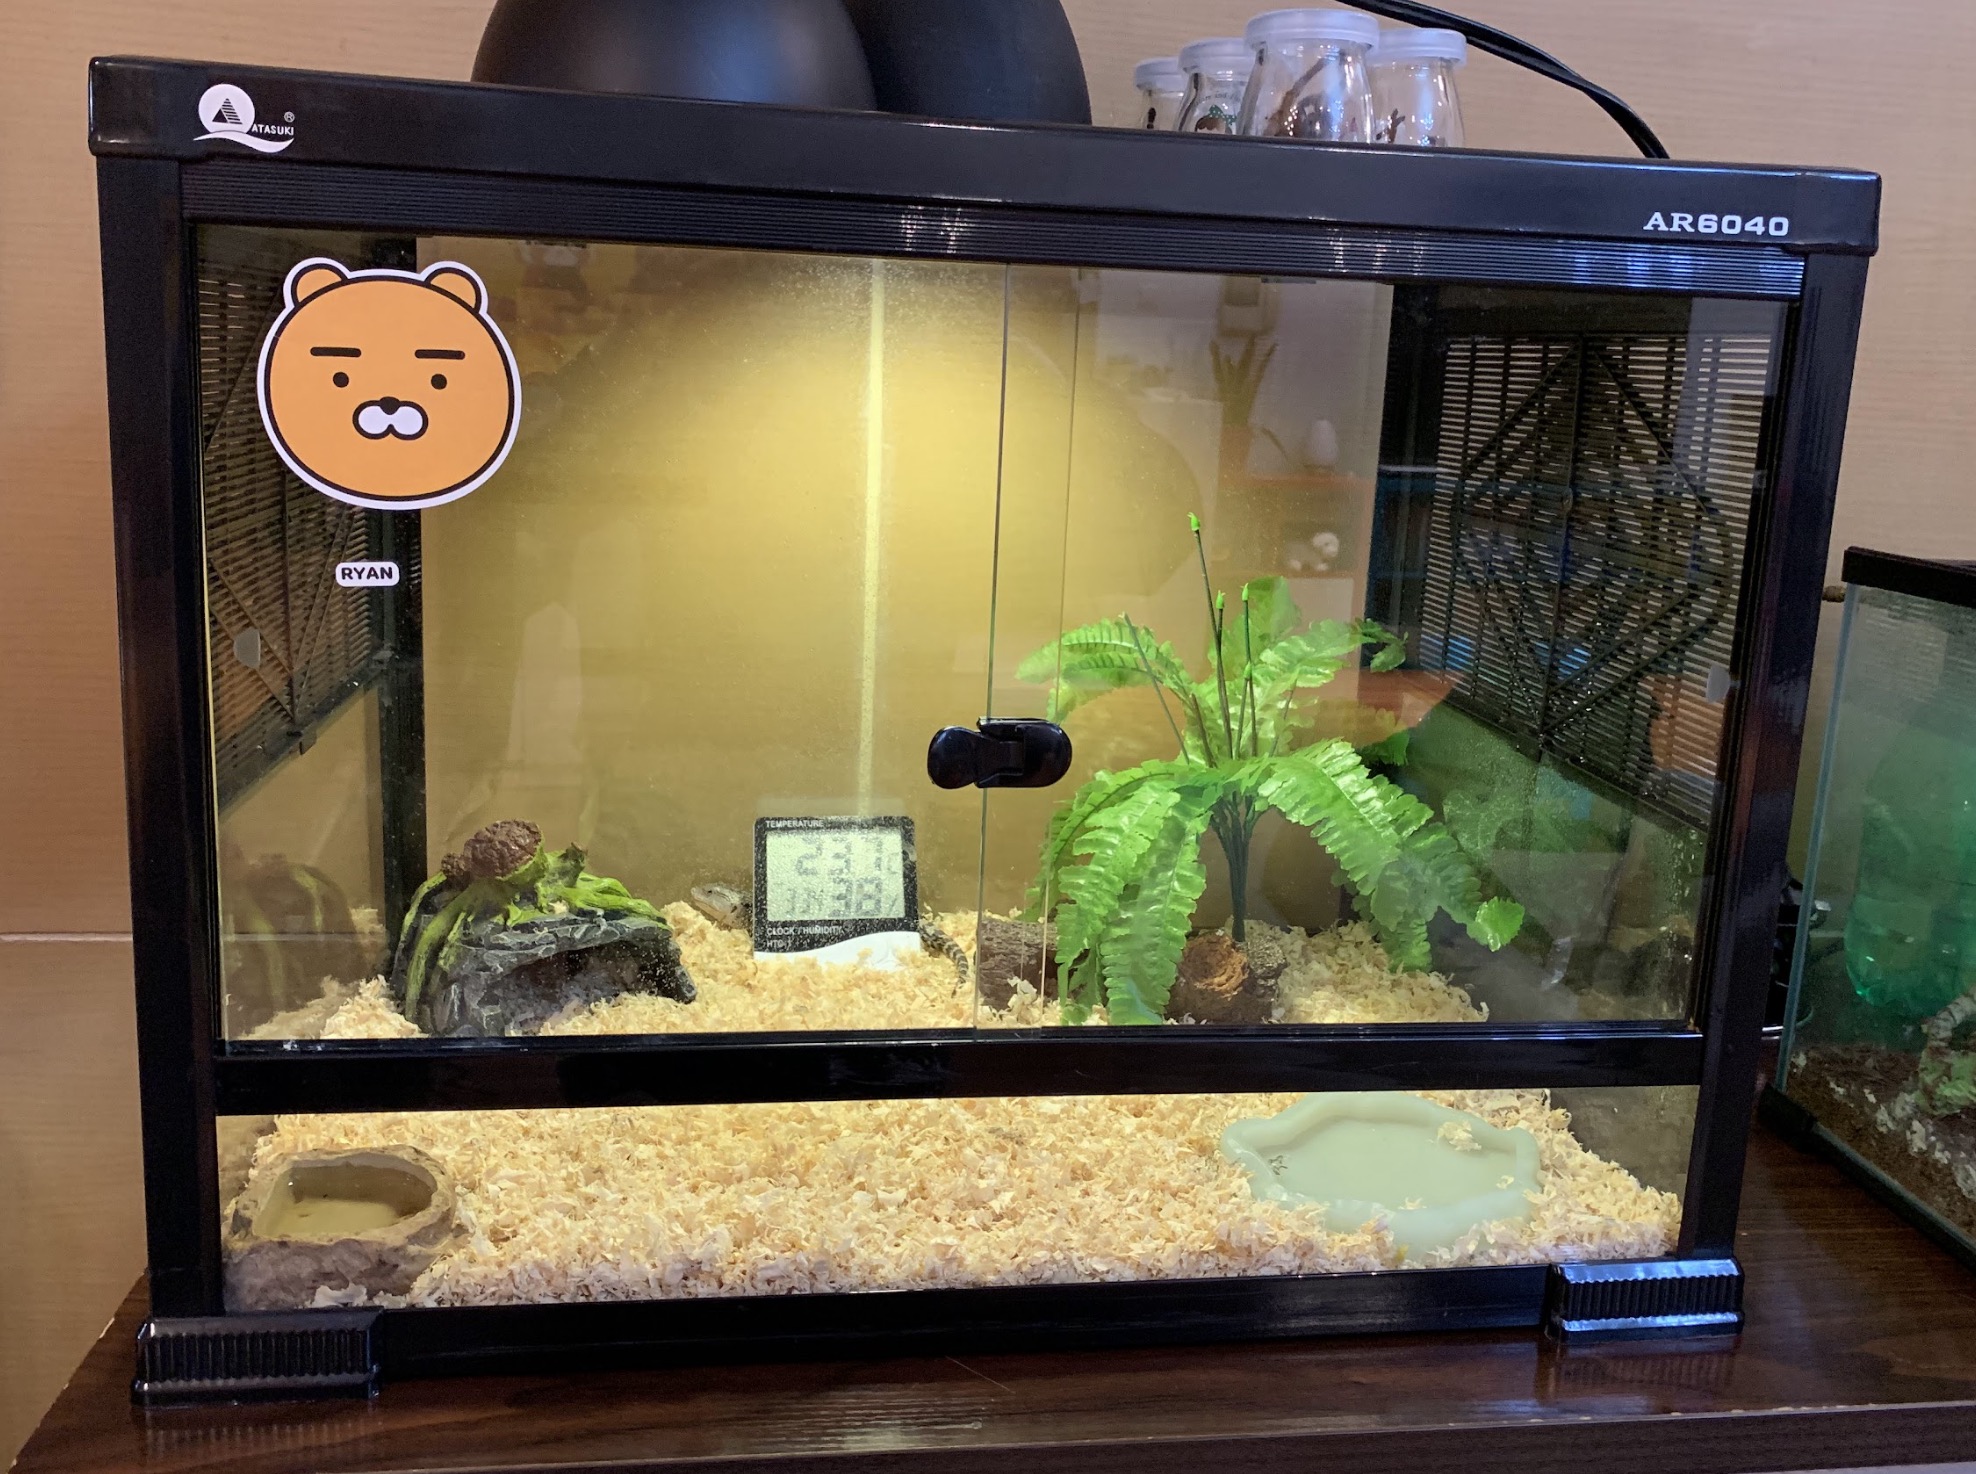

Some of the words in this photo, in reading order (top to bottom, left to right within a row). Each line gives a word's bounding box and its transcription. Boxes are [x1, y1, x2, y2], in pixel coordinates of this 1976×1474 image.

[1643, 211, 1789, 237] AR6040
[341, 566, 393, 580] RYAN
[765, 819, 824, 828] TEMPERATURE
[766, 926, 795, 936] CLOCK
[803, 925, 843, 935] HUMIDITY
